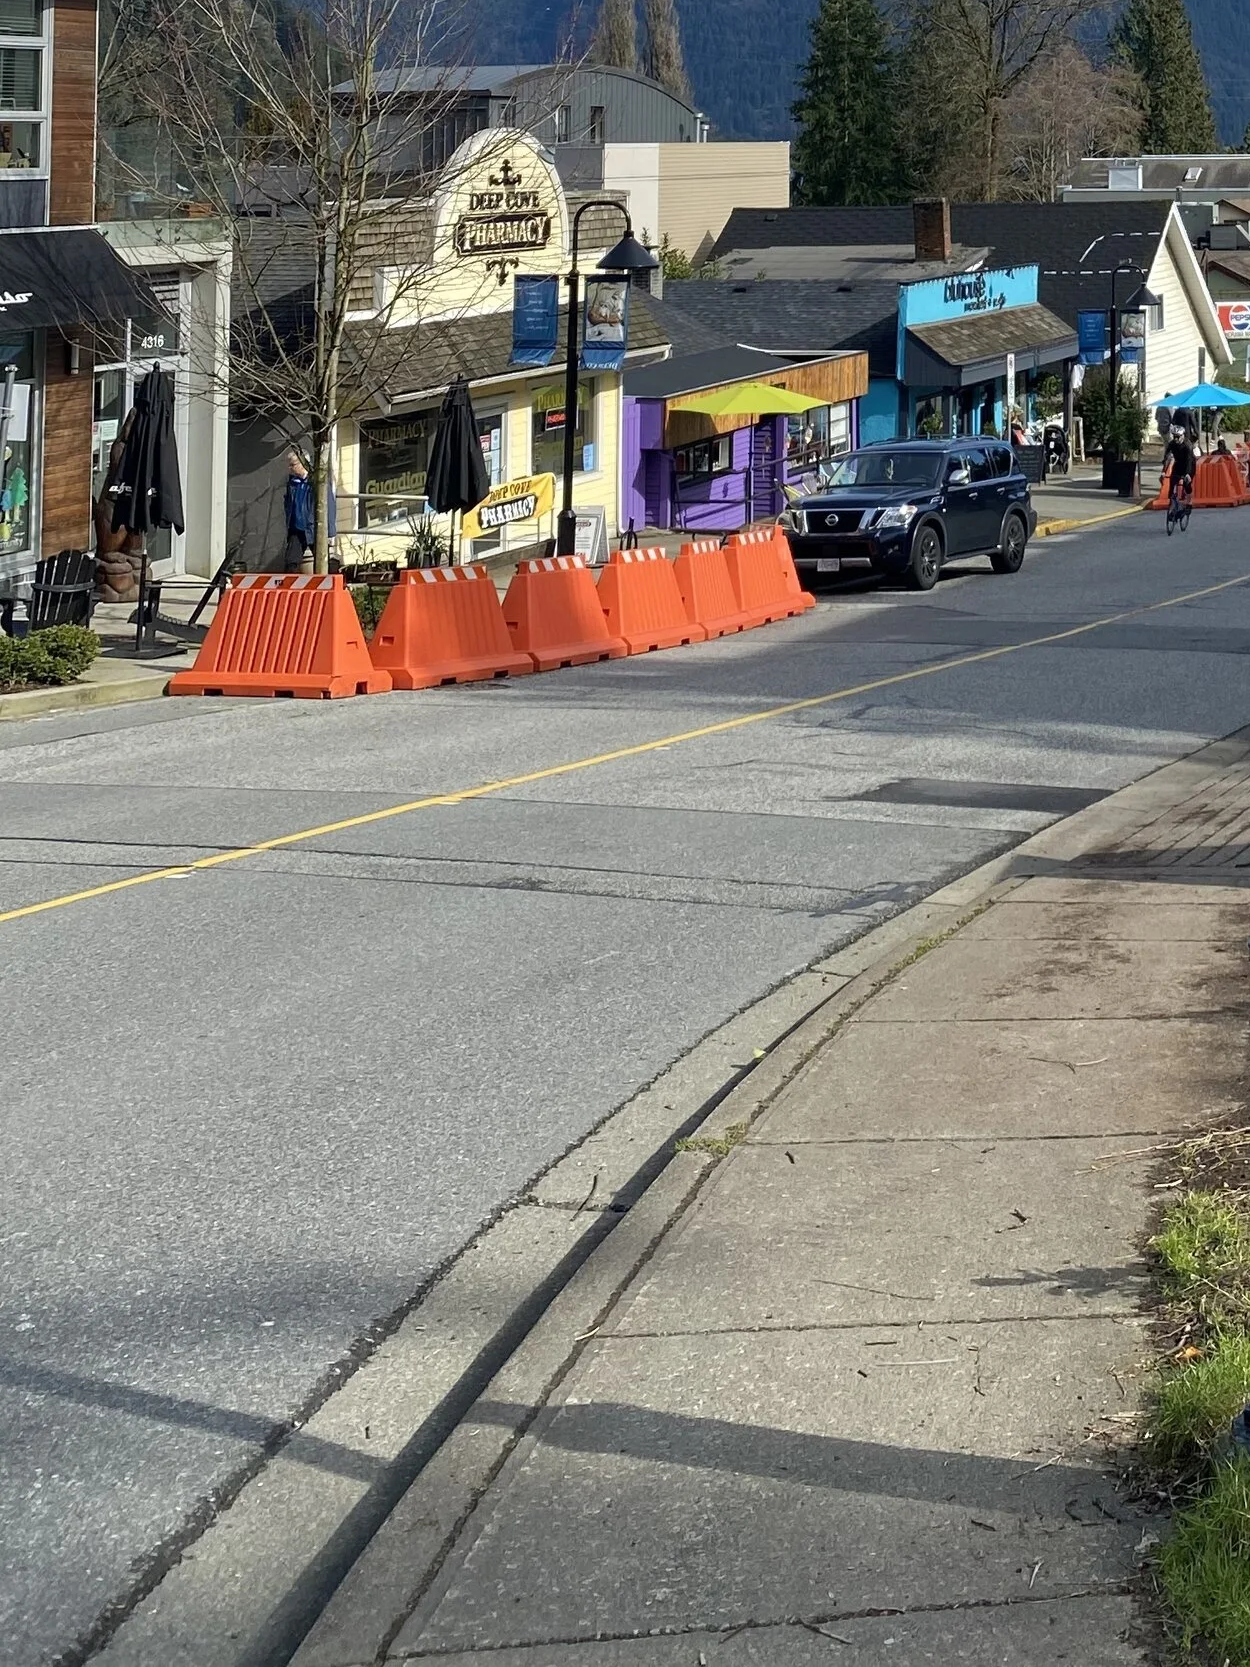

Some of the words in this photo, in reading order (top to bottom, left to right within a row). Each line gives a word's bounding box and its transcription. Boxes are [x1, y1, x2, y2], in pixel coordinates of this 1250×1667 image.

[468, 192, 504, 211] DEEP
[505, 190, 540, 210] COVE
[462, 215, 548, 251] PHARMACY
[1230, 313, 1250, 322] PEPSI
[140, 335, 164, 350] 4316
[366, 470, 427, 495] Guardian
[480, 495, 535, 529] PHARMACY
